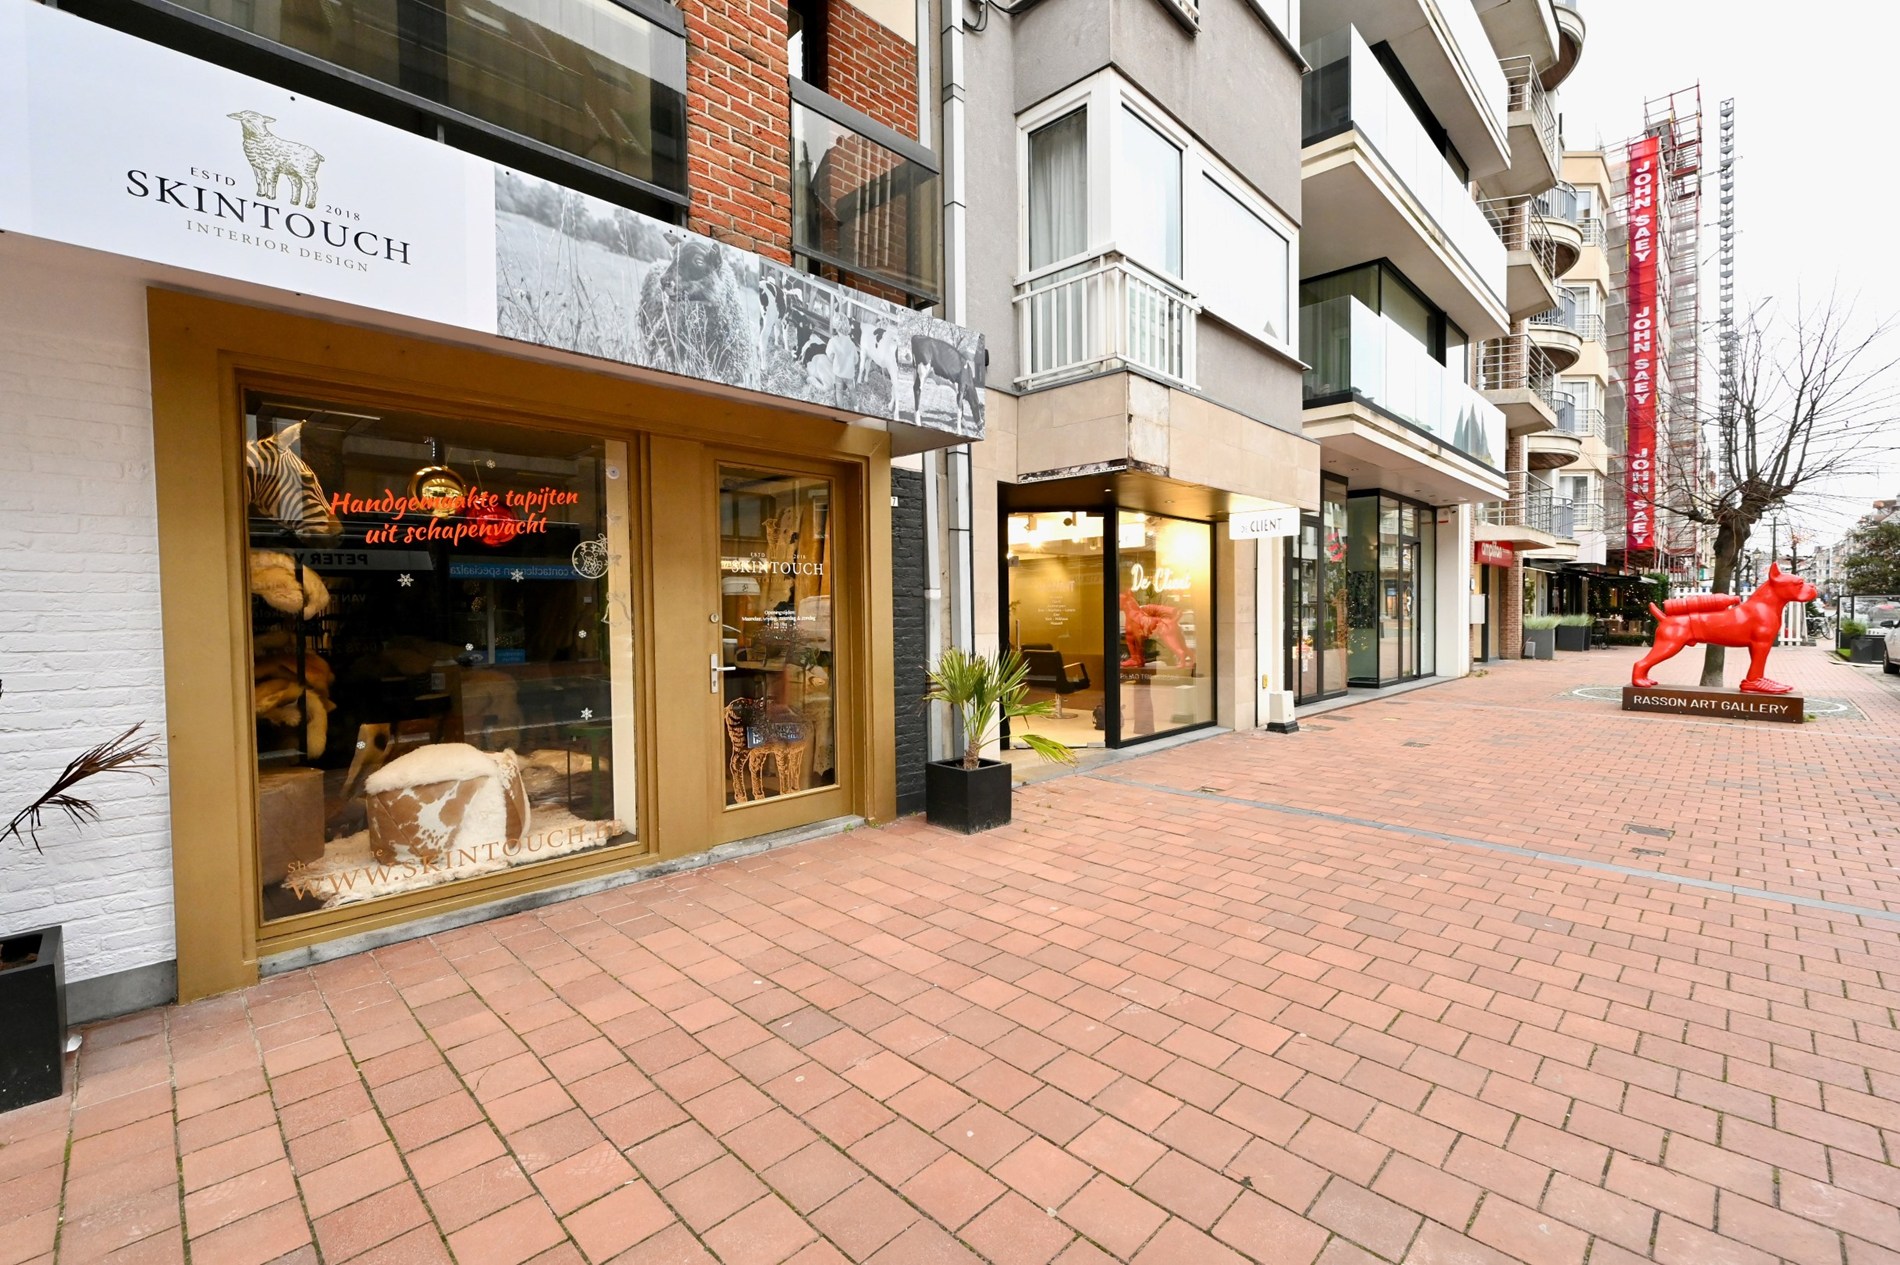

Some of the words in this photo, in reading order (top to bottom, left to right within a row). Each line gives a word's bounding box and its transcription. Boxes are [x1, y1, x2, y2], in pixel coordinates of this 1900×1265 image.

[190, 166, 236, 187] ESTD
[325, 204, 361, 221] 2018
[1633, 161, 1652, 212] JOHN
[126, 169, 411, 265] SKINTOUCH
[1633, 214, 1652, 262] SAEY
[187, 220, 290, 254] INTERIOR
[300, 247, 369, 272] DESIGN
[1633, 306, 1651, 354] JOHN
[1633, 359, 1650, 405] SAEY
[1632, 448, 1650, 493] JOHN
[330, 485, 500, 520] Handgemaakte
[505, 485, 578, 514] tapijten
[1250, 517, 1282, 533] CLIENT
[1632, 500, 1649, 544] SAEY
[365, 521, 398, 544] uit
[403, 512, 547, 546] schapenvacht
[731, 560, 824, 575] SKINTOUCH
[1131, 563, 1152, 592] De
[1153, 567, 1192, 593] Client
[1633, 695, 1687, 707] RASSON
[1690, 698, 1718, 710] ART
[1721, 700, 1789, 714] GALLERY
[289, 820, 622, 901] WWW.SKINTOUCH.BE
